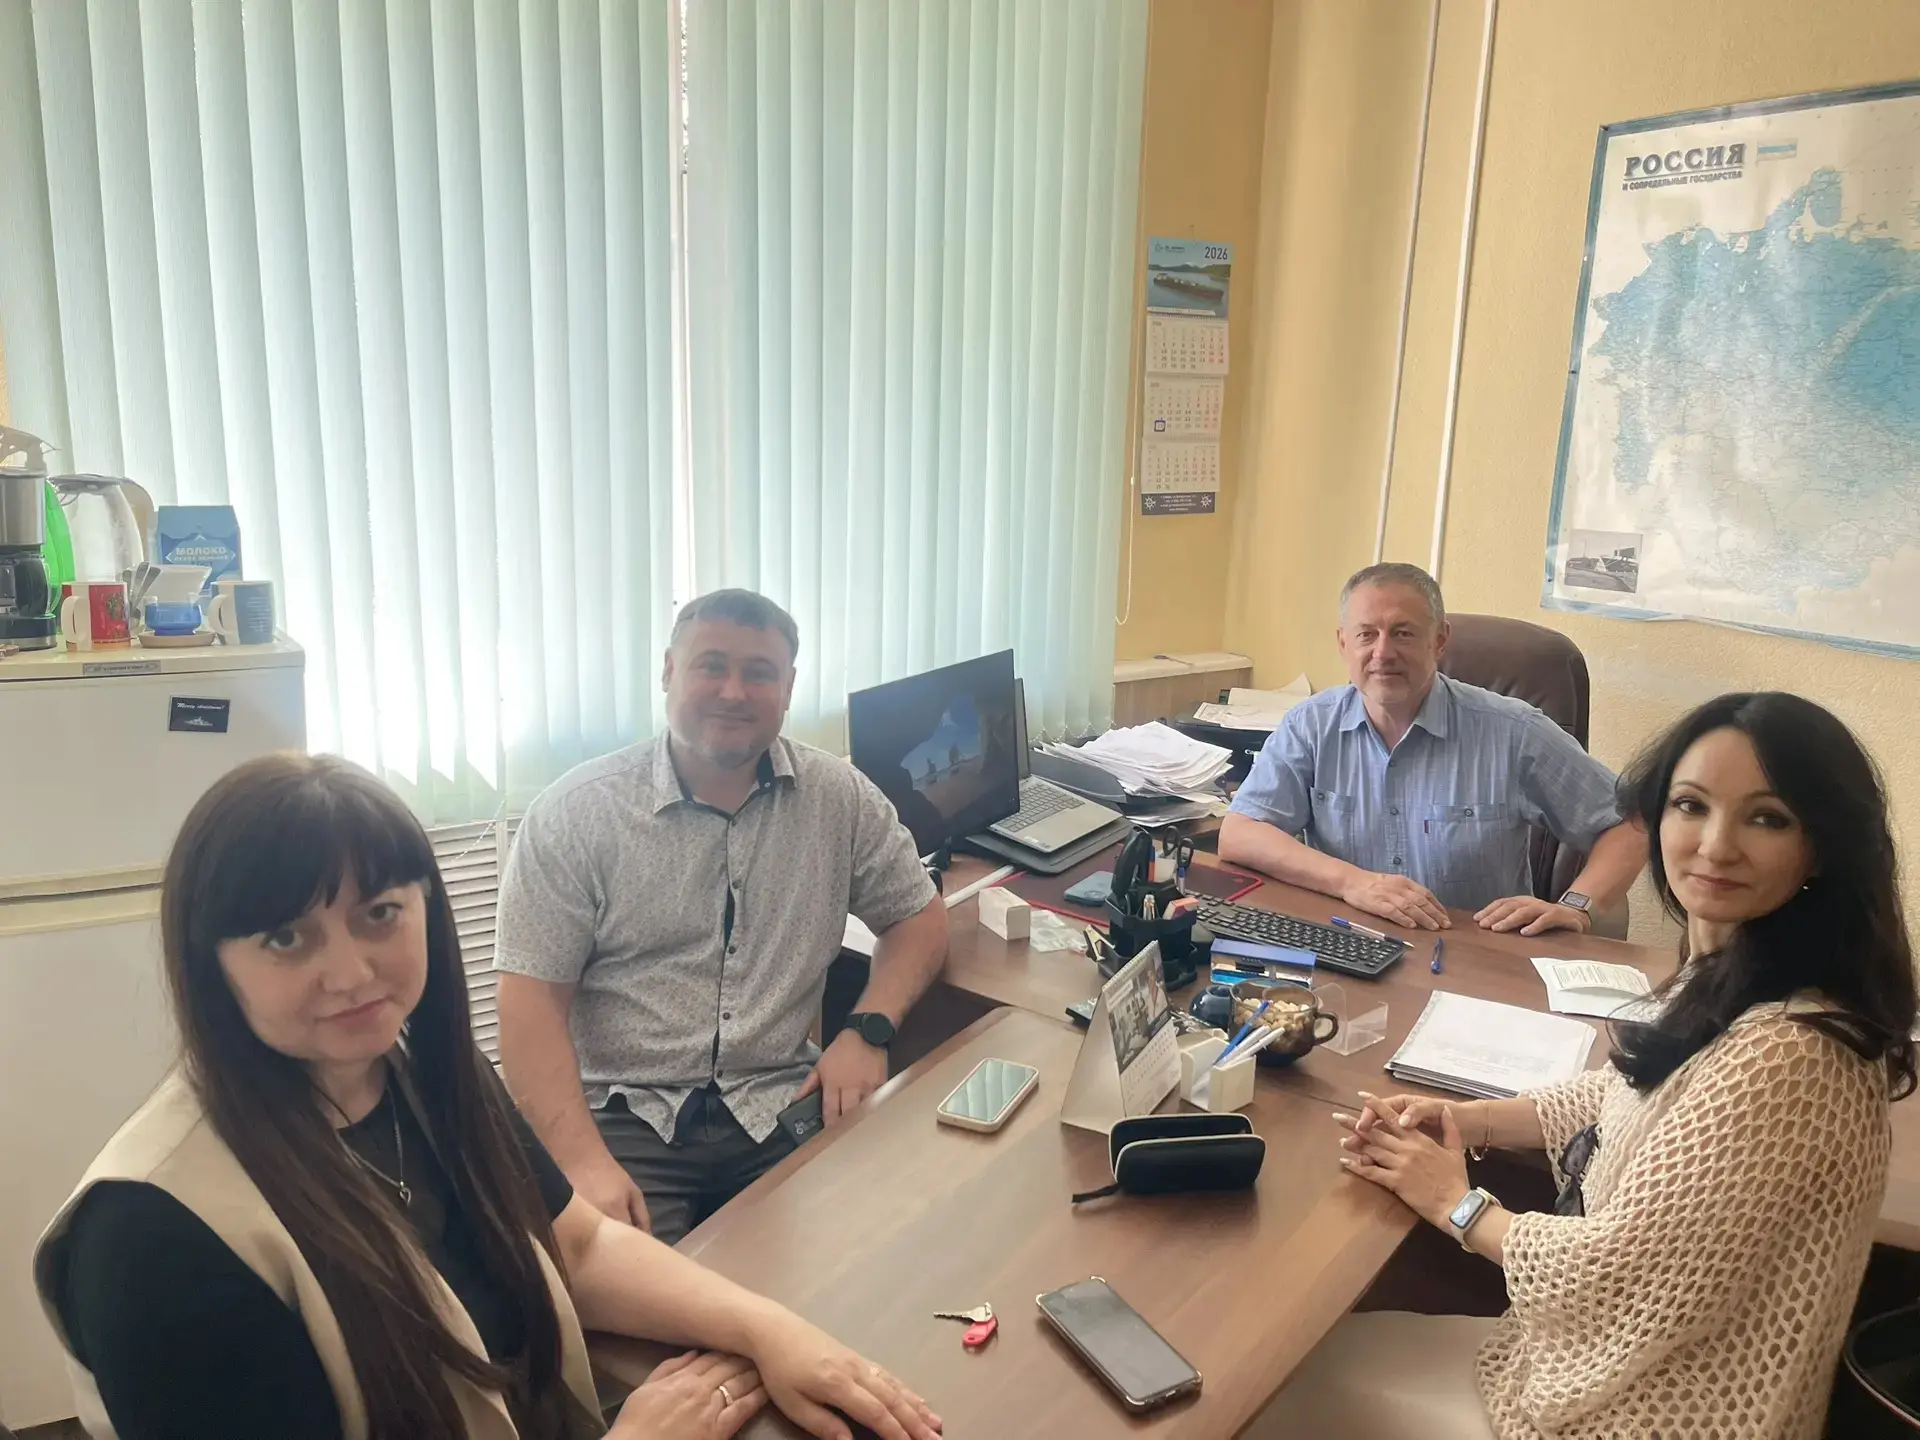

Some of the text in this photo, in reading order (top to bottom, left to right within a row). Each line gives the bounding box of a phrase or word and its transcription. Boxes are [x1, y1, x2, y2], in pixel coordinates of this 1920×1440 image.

[1624, 143, 1746, 176] РОССИЯ
[1622, 170, 1742, 191] И СОПРЕДЕЛЬНЫЕ ГОСУДАРСТВА
[1204, 246, 1228, 260] 2026
[176, 546, 226, 555] МОЛОКО
